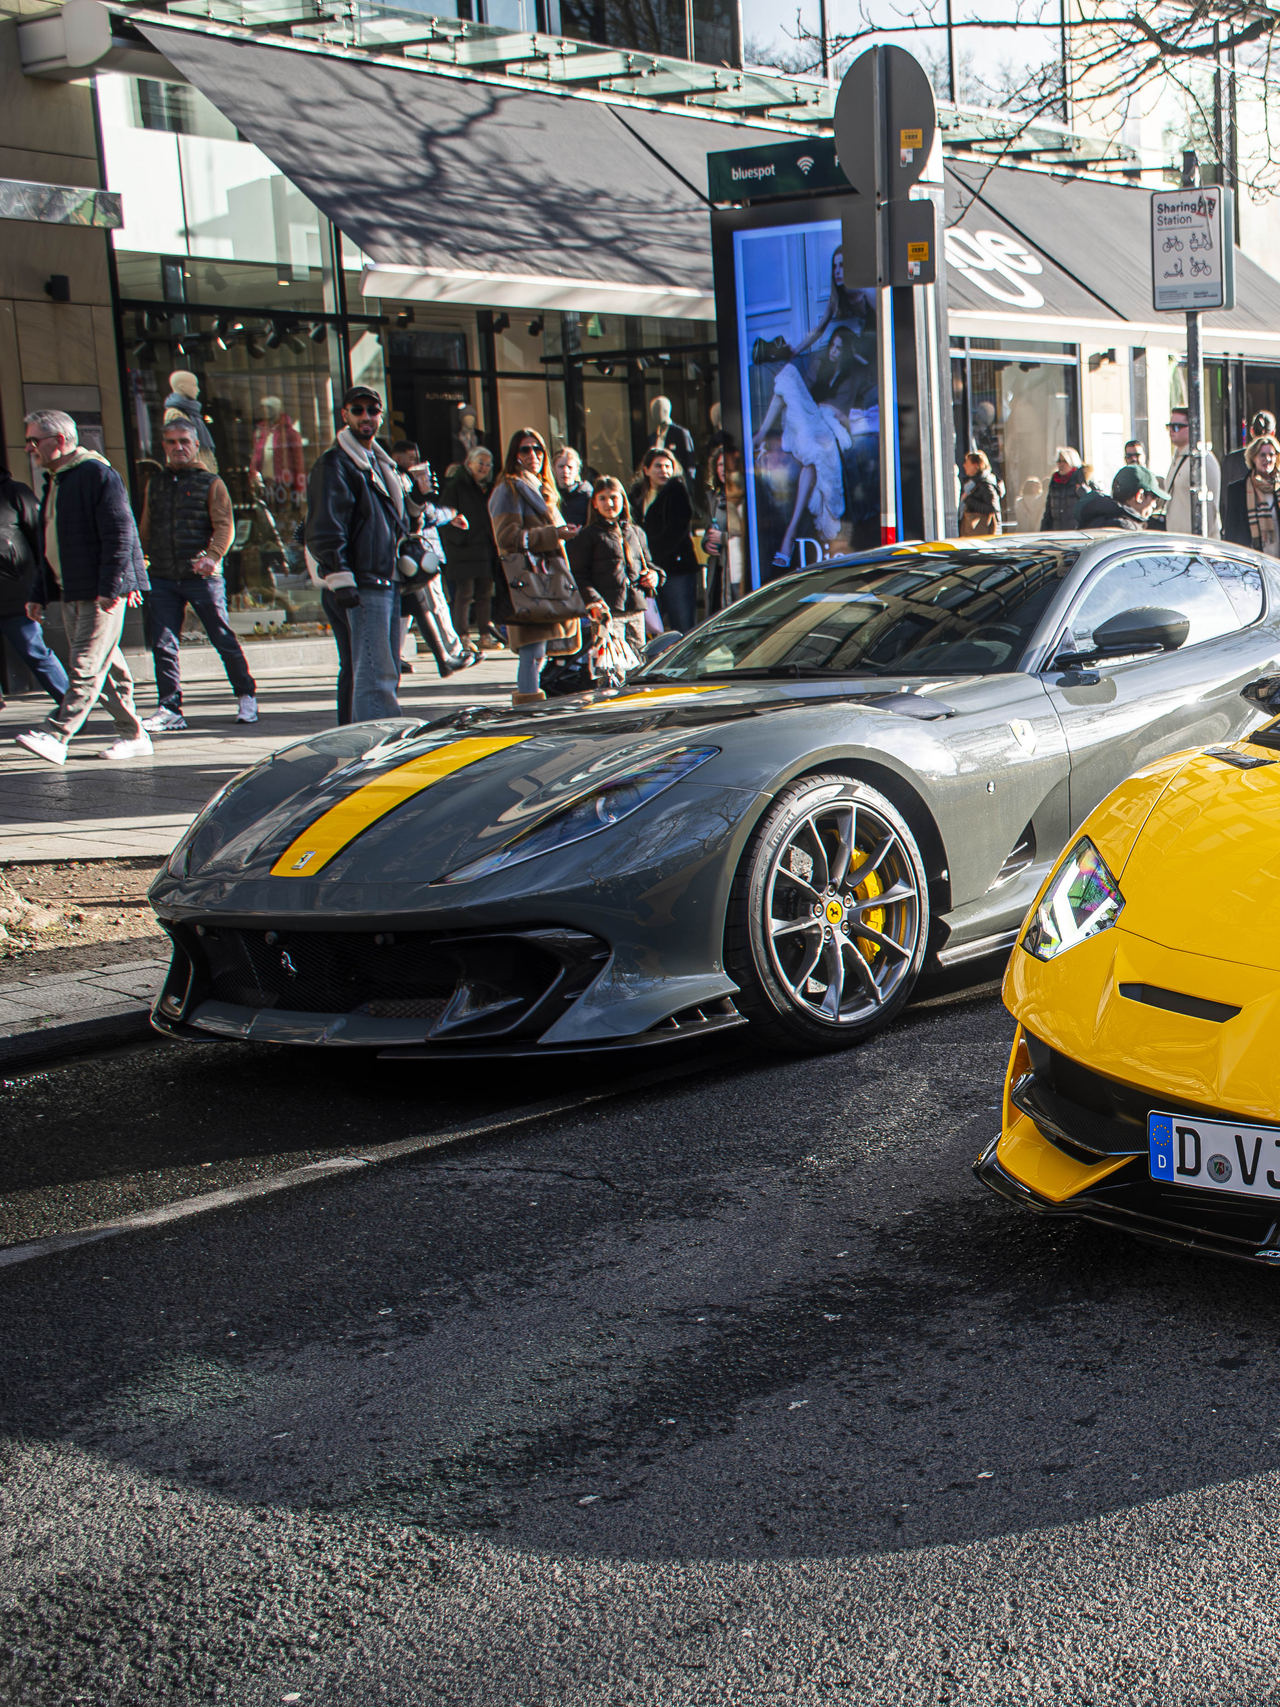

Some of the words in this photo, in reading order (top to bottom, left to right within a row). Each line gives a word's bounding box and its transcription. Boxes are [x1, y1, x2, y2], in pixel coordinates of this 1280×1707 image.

[731, 164, 776, 181] bluespot
[1157, 201, 1197, 214] Sharing
[1157, 214, 1193, 227] Station
[1174, 1125, 1202, 1178] D
[1157, 1154, 1168, 1169] D
